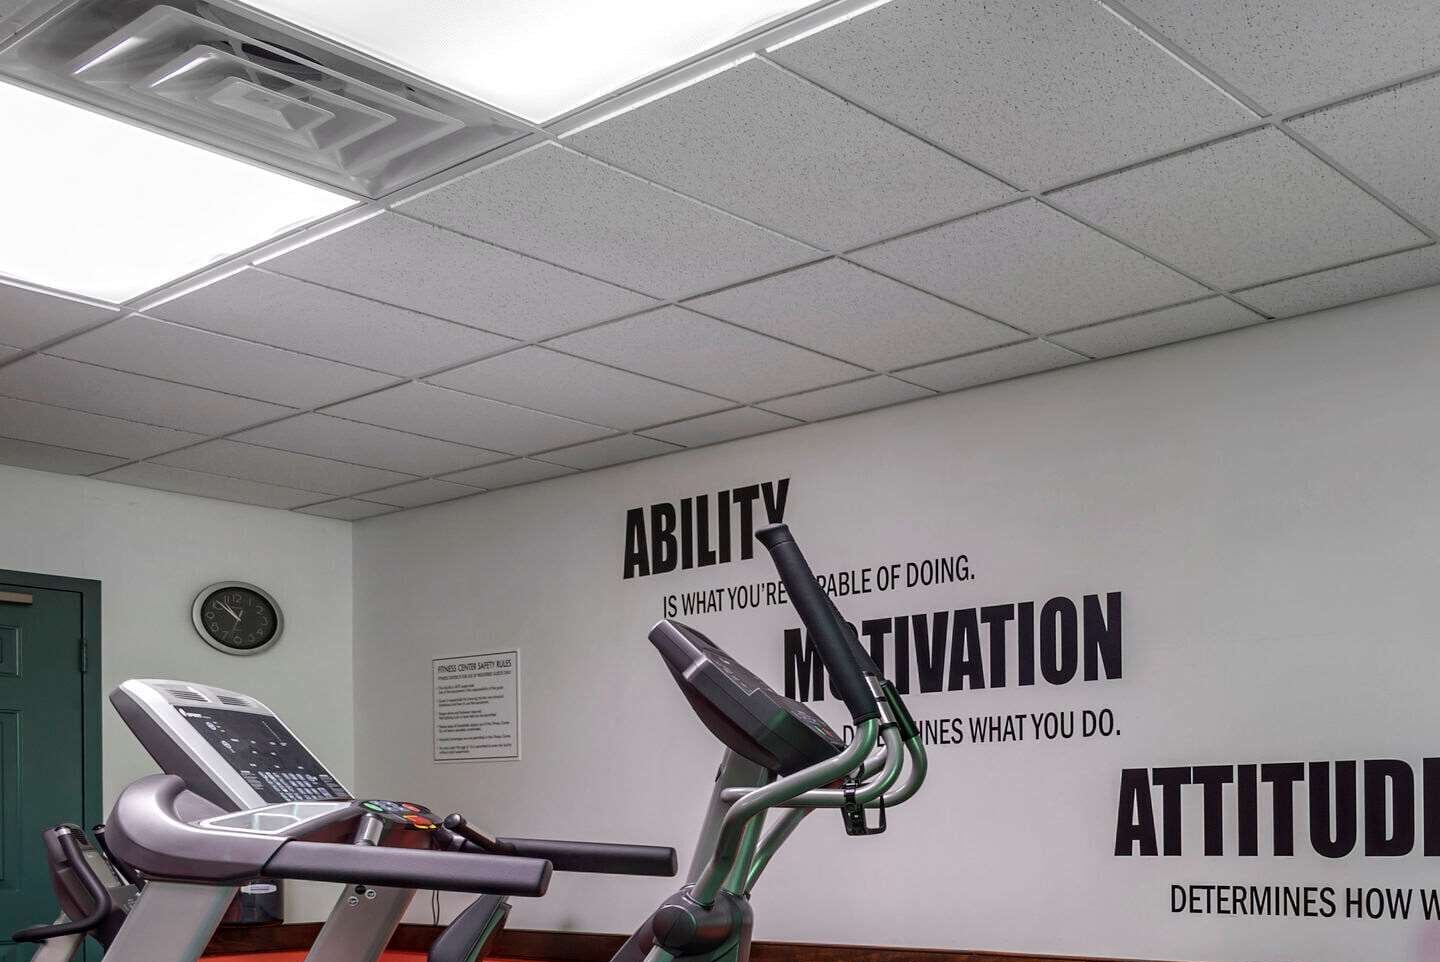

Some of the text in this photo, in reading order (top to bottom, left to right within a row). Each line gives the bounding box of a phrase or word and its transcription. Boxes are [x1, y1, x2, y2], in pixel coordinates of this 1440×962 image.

[623, 478, 790, 579] ABILITY
[663, 554, 975, 618] IS WHAT YOU'RE PABLE OF DOING.
[457, 662, 477, 672] CENTER
[477, 660, 495, 671] SAFETY
[496, 659, 512, 668] RULES
[784, 591, 1122, 702] MTIVATION
[968, 714, 1027, 742] WHAT
[1031, 710, 1074, 740] YOU
[1082, 708, 1121, 738] DO.
[1171, 884, 1336, 918] DETERMINES
[1346, 887, 1413, 920] HOW
